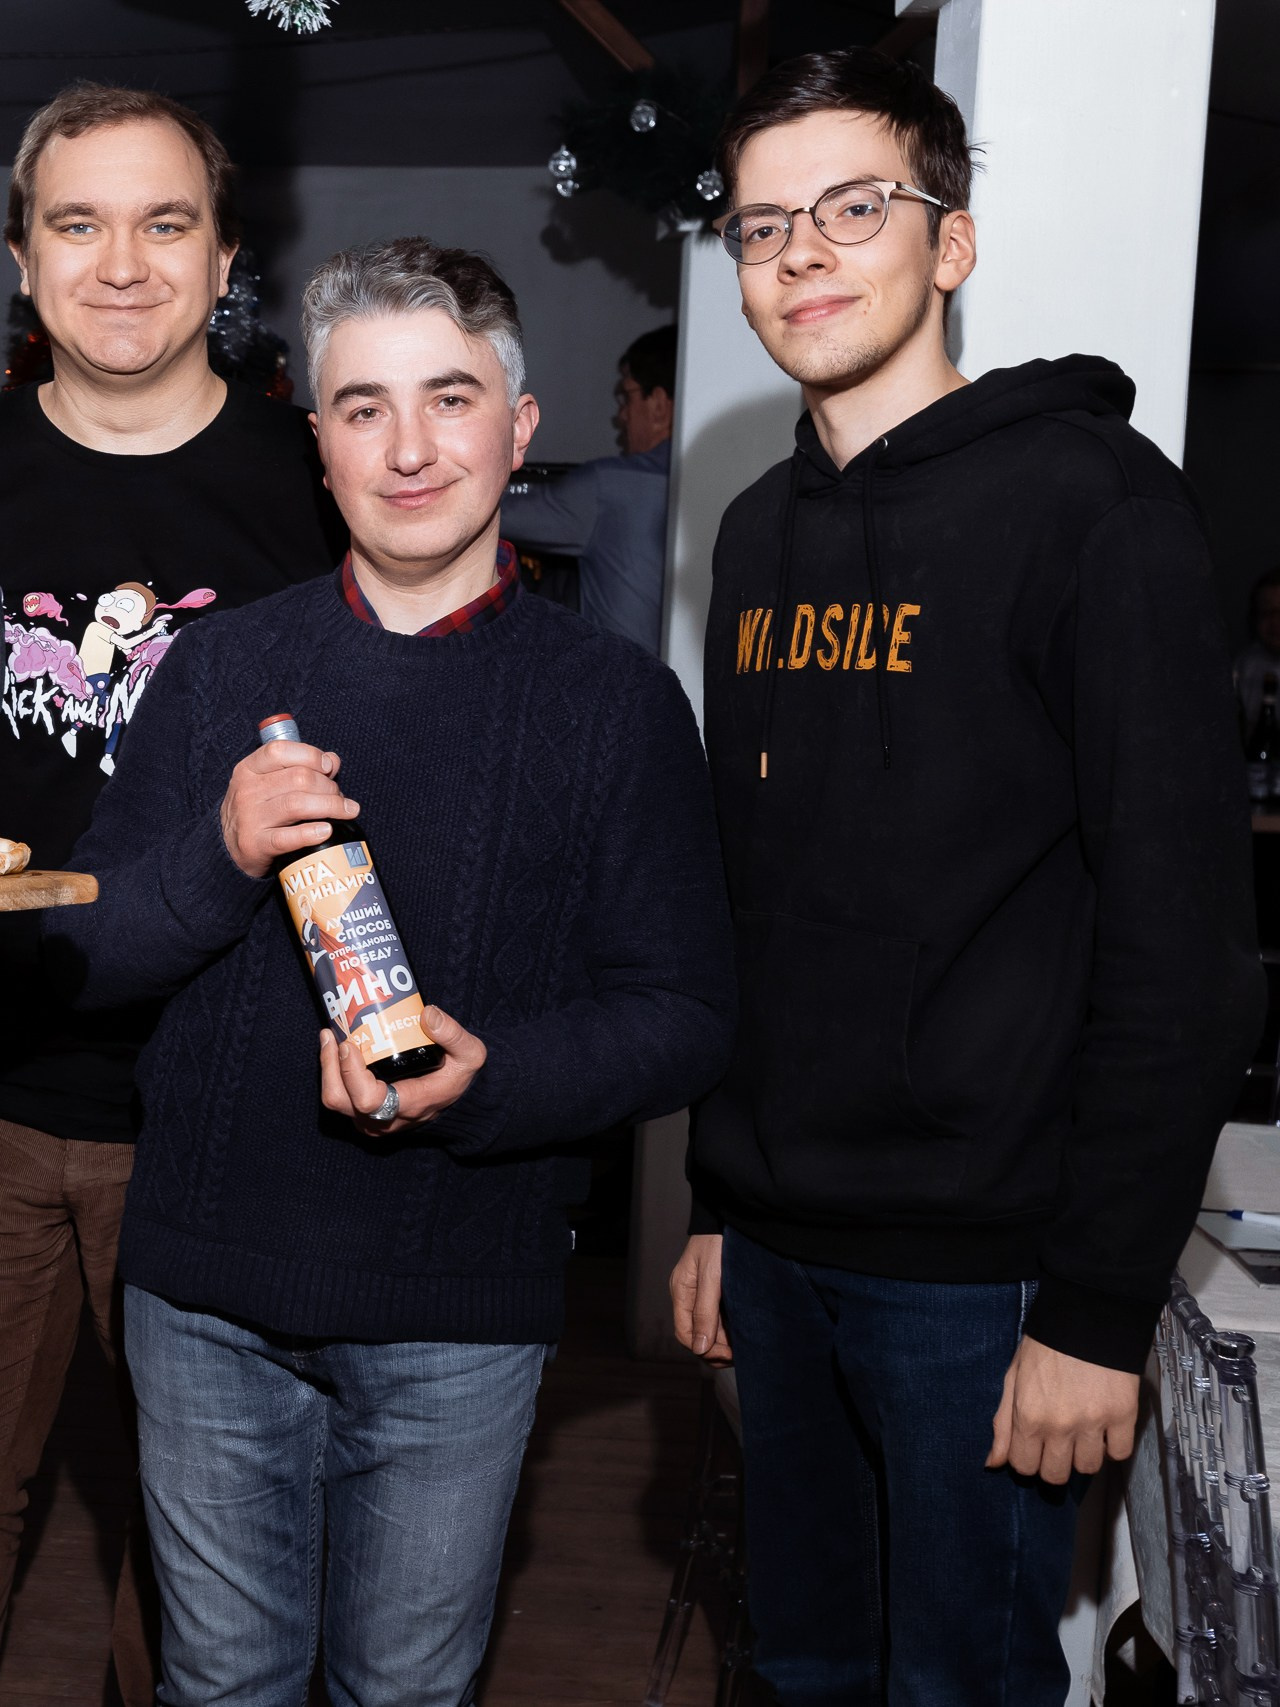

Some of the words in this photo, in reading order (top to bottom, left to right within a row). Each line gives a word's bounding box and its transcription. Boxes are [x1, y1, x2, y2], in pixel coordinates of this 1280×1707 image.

[735, 602, 922, 675] WIDSIDE
[283, 860, 337, 900] ЛИГА
[308, 871, 376, 903] ИНДИГО
[325, 902, 384, 932] ЛУЧШИЙ
[335, 919, 392, 944] СПОСОБ
[328, 933, 398, 961] ОТПРАЗДНОВАТЬ
[339, 946, 392, 973] ПОБЕДУ
[322, 964, 414, 1020] ВИНО
[360, 1011, 394, 1055] 1
